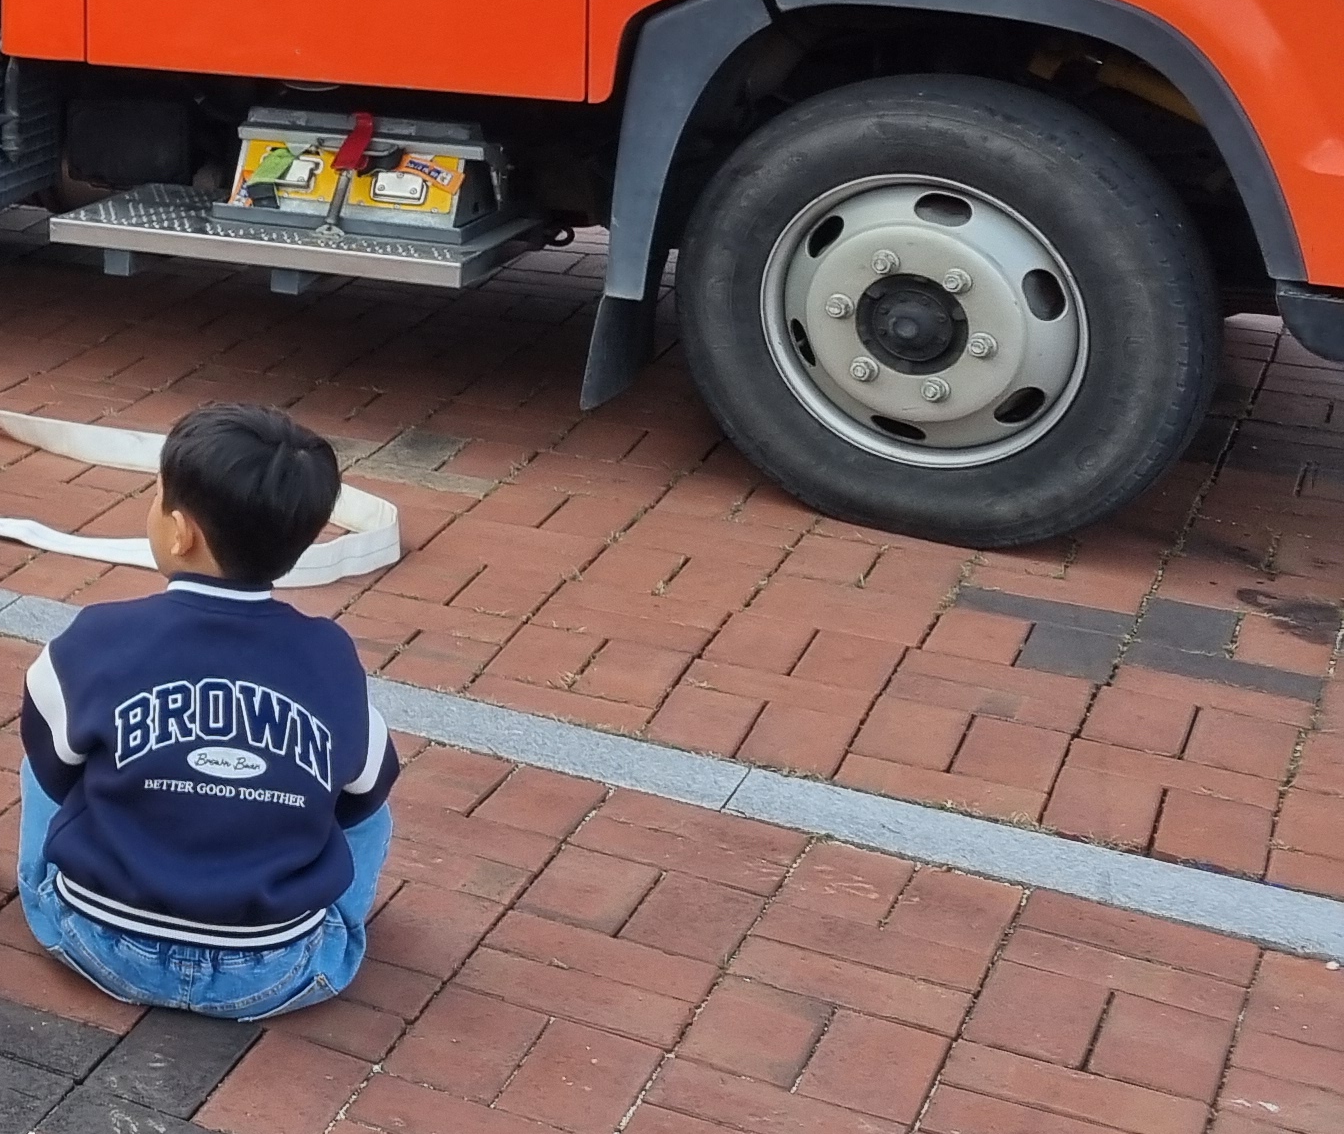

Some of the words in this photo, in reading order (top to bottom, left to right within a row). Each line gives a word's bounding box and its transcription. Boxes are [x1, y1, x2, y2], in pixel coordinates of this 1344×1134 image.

[114, 677, 332, 793] BROWN
[143, 778, 195, 795] BETTER
[196, 782, 235, 799] GOOD
[238, 787, 306, 809] TOGETHER
